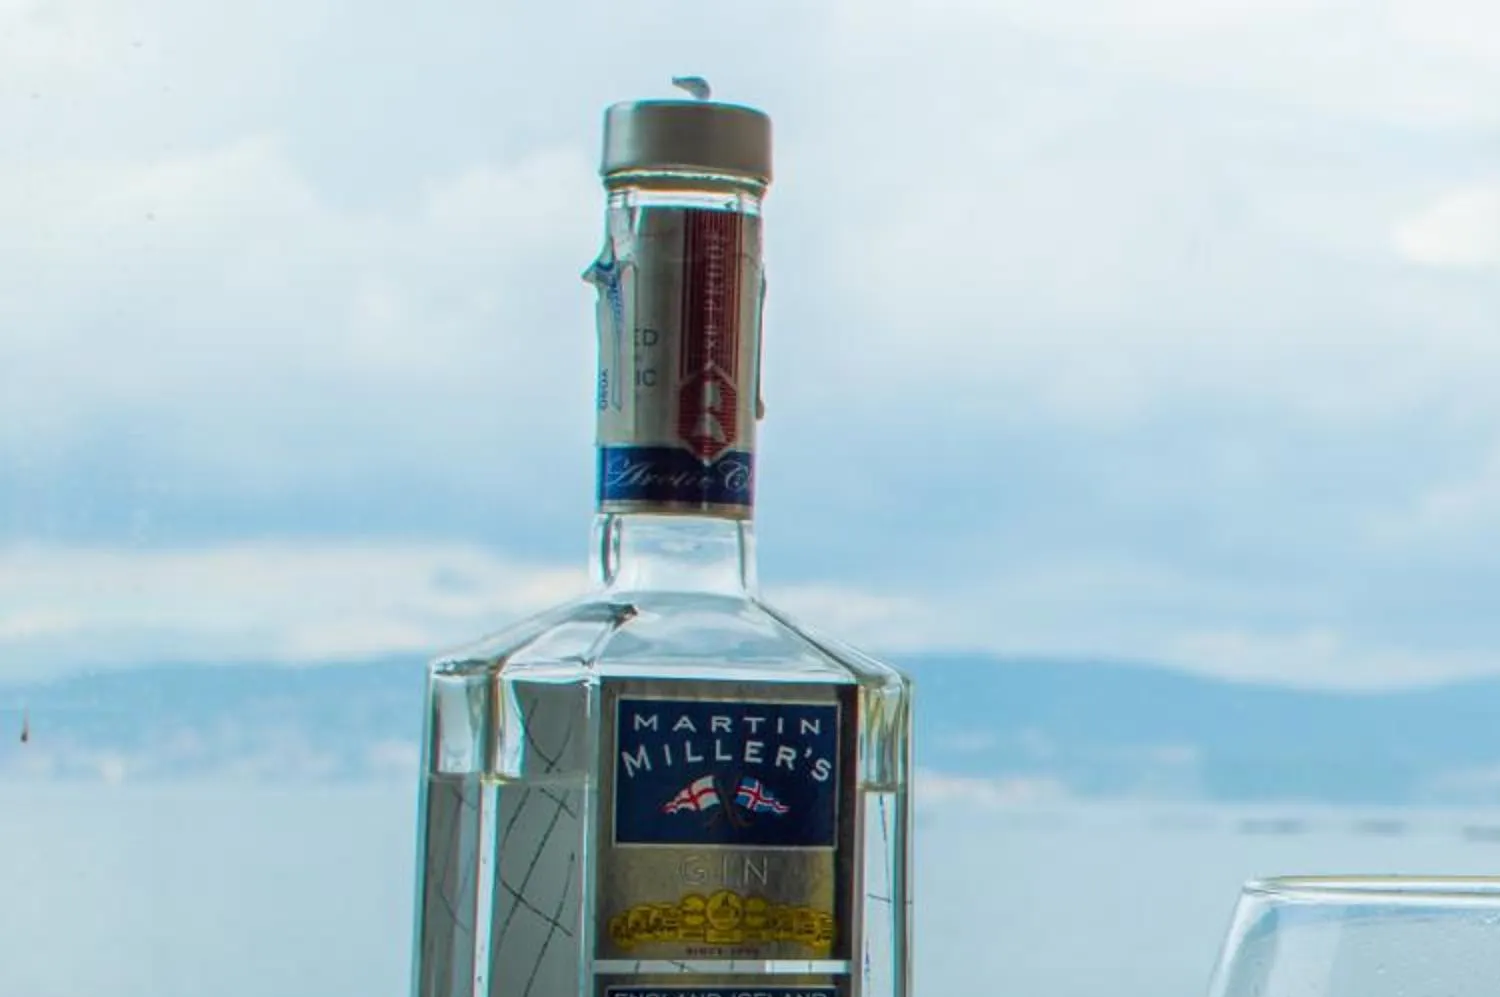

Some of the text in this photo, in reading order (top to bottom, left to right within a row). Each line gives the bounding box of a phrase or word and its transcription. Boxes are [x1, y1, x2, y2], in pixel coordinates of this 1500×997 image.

[633, 714, 822, 736] MARTIN
[621, 739, 832, 782] MILLER'S
[678, 855, 768, 886] GIN
